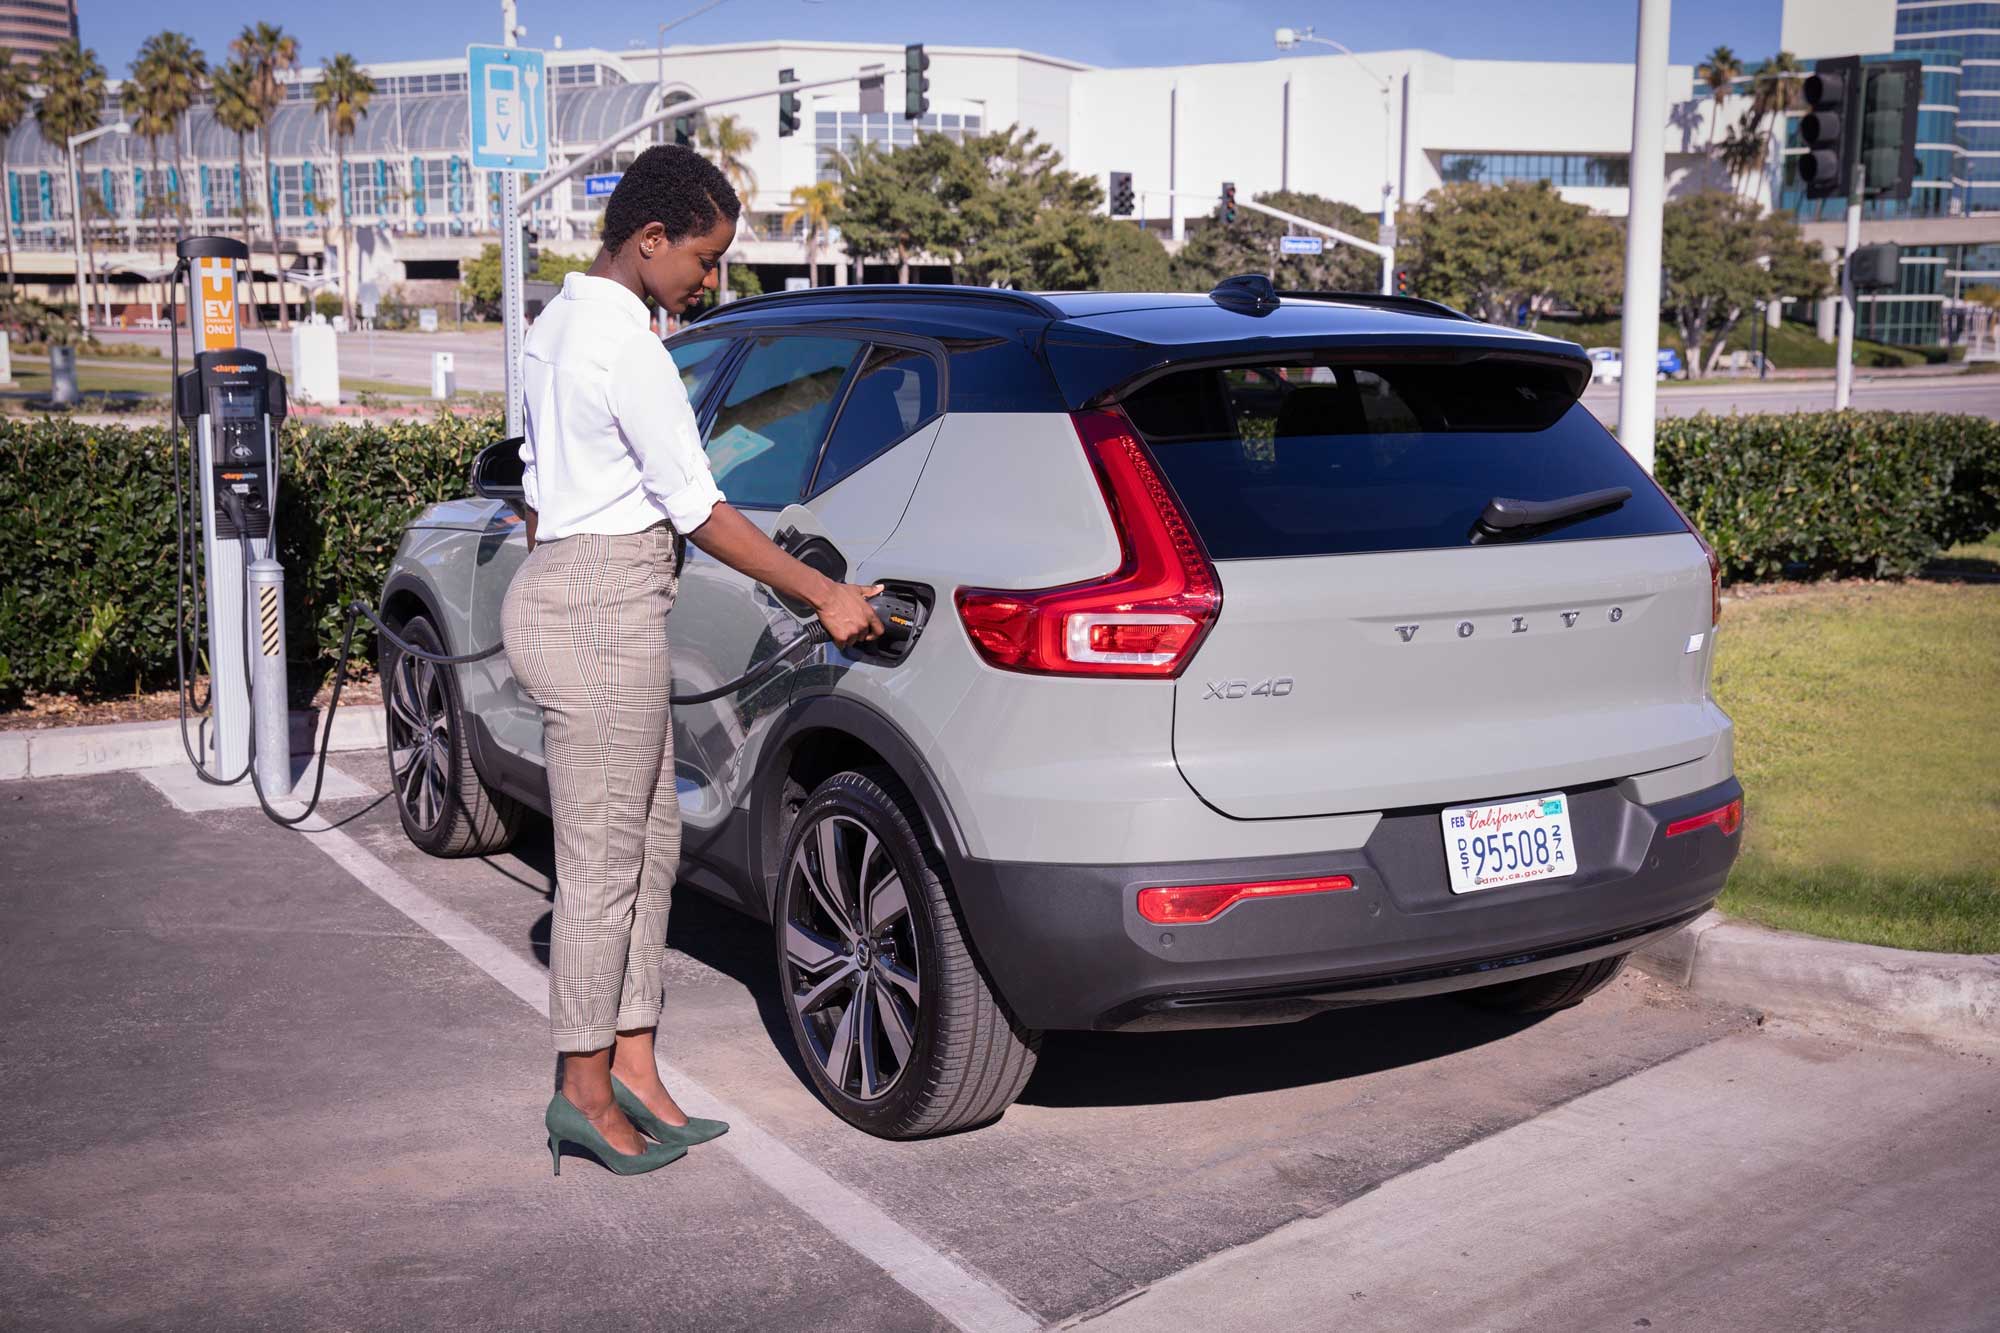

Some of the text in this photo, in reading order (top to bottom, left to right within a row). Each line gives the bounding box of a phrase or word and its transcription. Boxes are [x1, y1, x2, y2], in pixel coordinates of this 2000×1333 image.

[496, 98, 511, 141] EV
[205, 300, 232, 318] EV
[206, 325, 234, 335] ONLY
[1394, 607, 1623, 643] VOLVO
[1202, 678, 1294, 700] XC40
[1450, 816, 1466, 829] FEB
[1468, 807, 1545, 832] California
[1472, 827, 1549, 876] 95508
[1481, 868, 1544, 884] dmv.ca.gov
